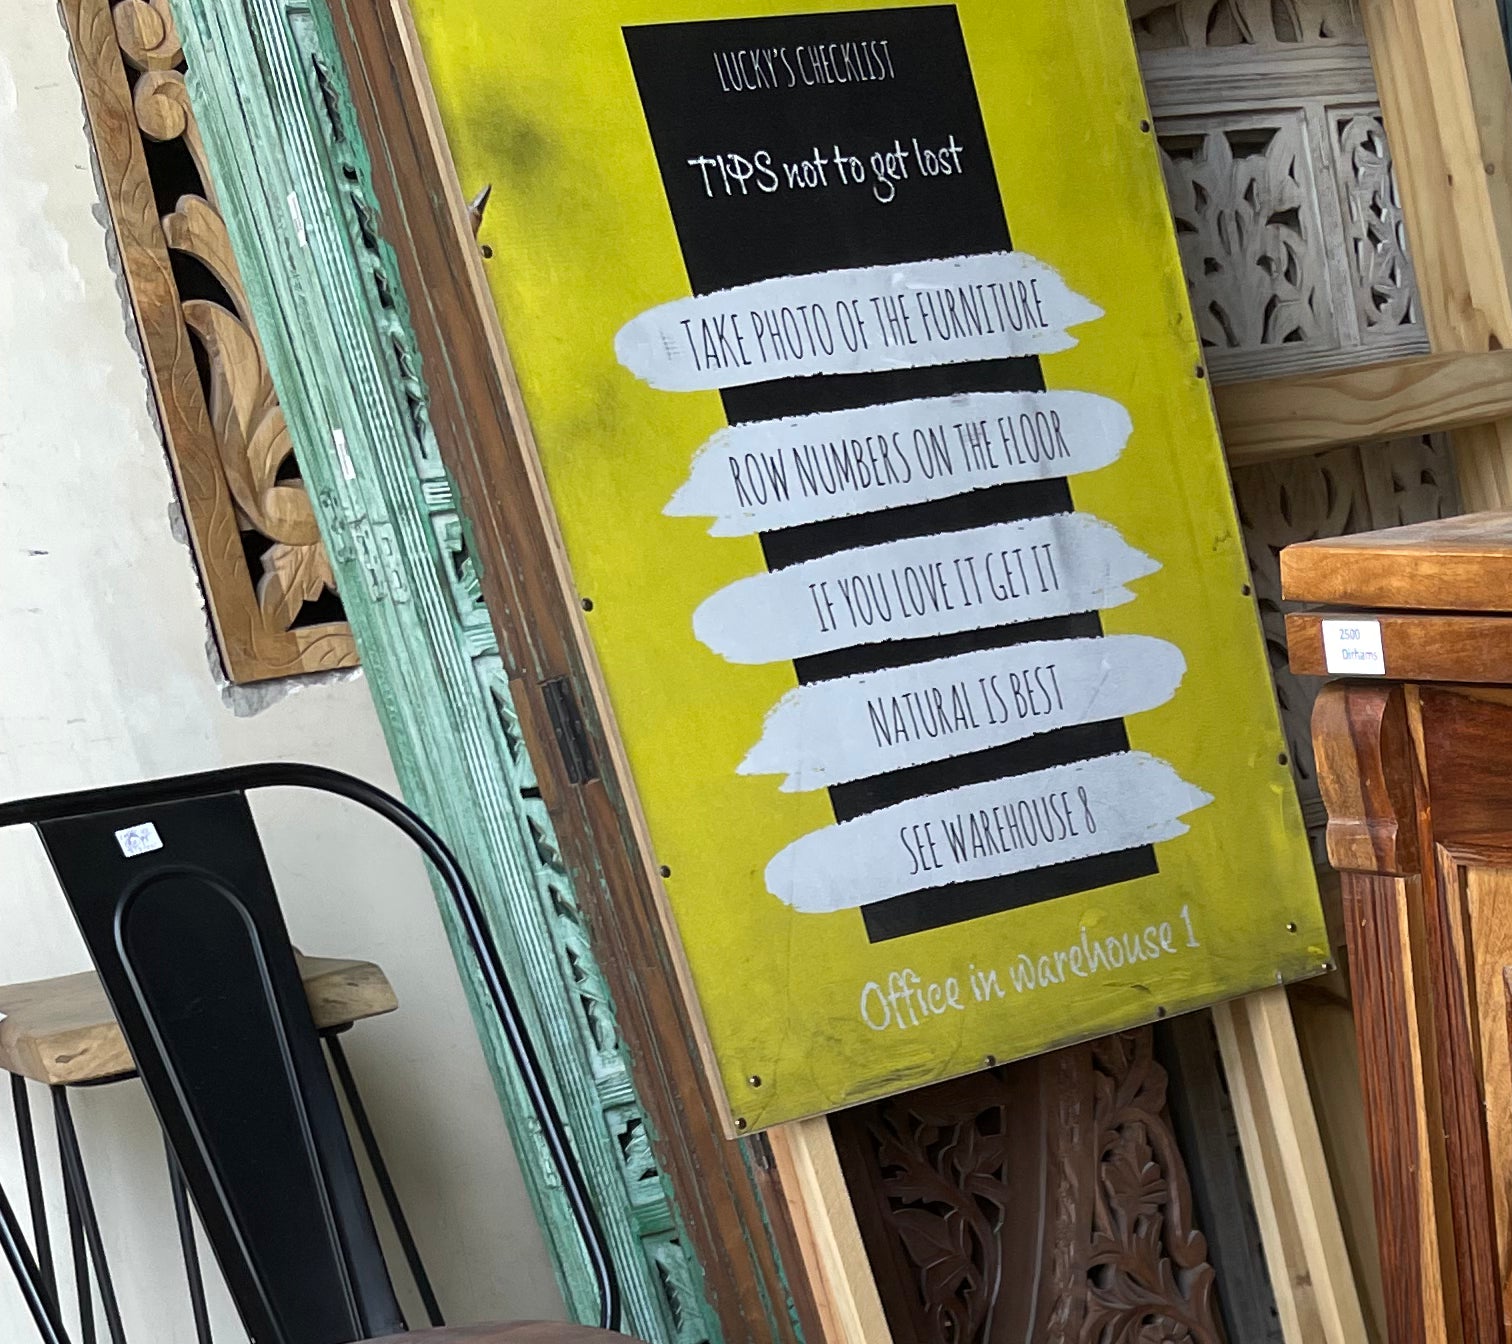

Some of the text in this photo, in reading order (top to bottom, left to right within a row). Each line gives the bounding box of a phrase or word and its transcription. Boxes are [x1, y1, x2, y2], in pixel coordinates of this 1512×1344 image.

[713, 40, 895, 92] LUCKY'S CHECKLIST
[687, 134, 964, 203] TIPS not to get lost
[680, 278, 1049, 371] TAKE PHOTO OF THE FURNITURE
[728, 409, 1072, 508] ROW NUMBERS ON THE FLOOR
[808, 542, 1060, 632] IF YOU LOVE IT GET IT
[867, 664, 1064, 748] NATURAL IS BEST
[899, 785, 1097, 875] SEE WAREHOUSE 8
[860, 904, 1201, 1031] Office in warehouse 1
